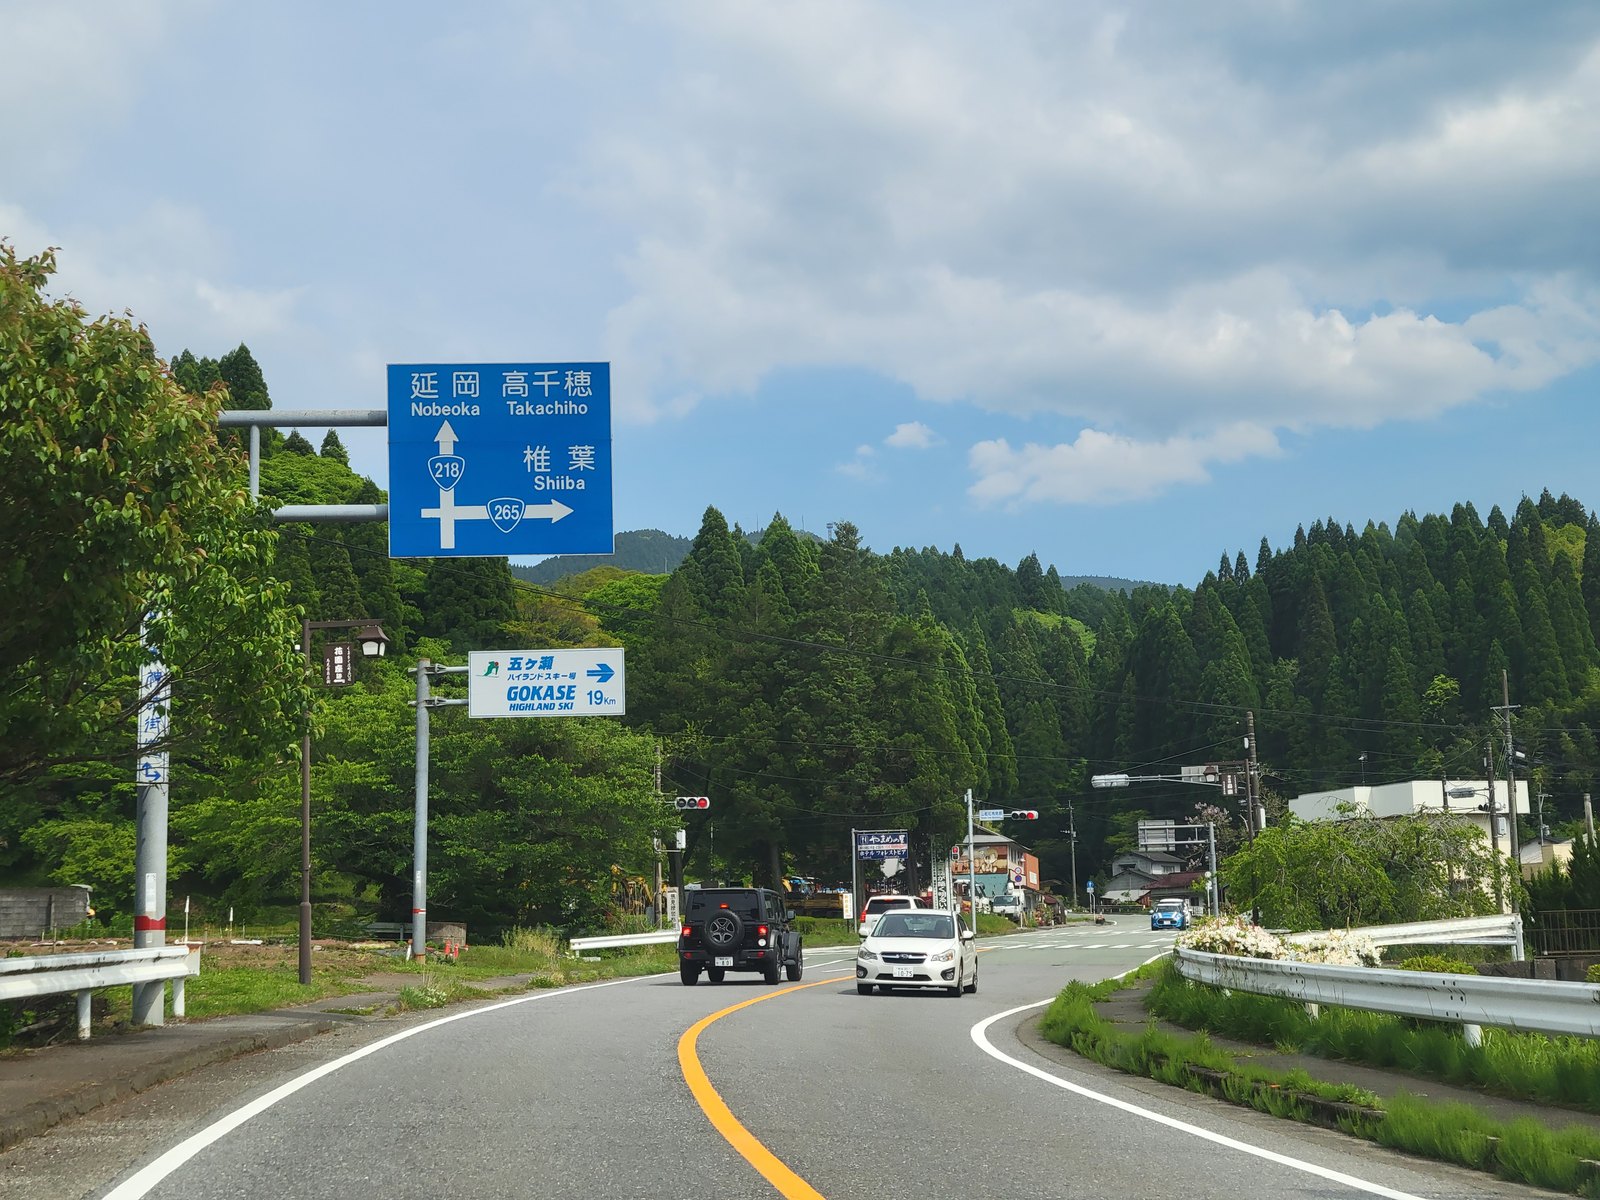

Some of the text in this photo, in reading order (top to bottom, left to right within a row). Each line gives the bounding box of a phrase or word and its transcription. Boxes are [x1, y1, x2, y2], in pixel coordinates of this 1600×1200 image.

[411, 371, 479, 399] 延岡
[502, 370, 593, 397] 高千穂
[411, 402, 480, 416] Nobeoka
[506, 401, 588, 416] Takachiho
[523, 445, 595, 472] 椎葉
[434, 462, 459, 478] 218
[534, 475, 586, 490] Shiiba
[494, 505, 520, 520] 265
[507, 685, 577, 701] GOKASE
[509, 702, 573, 711] HIGHLAND SKI
